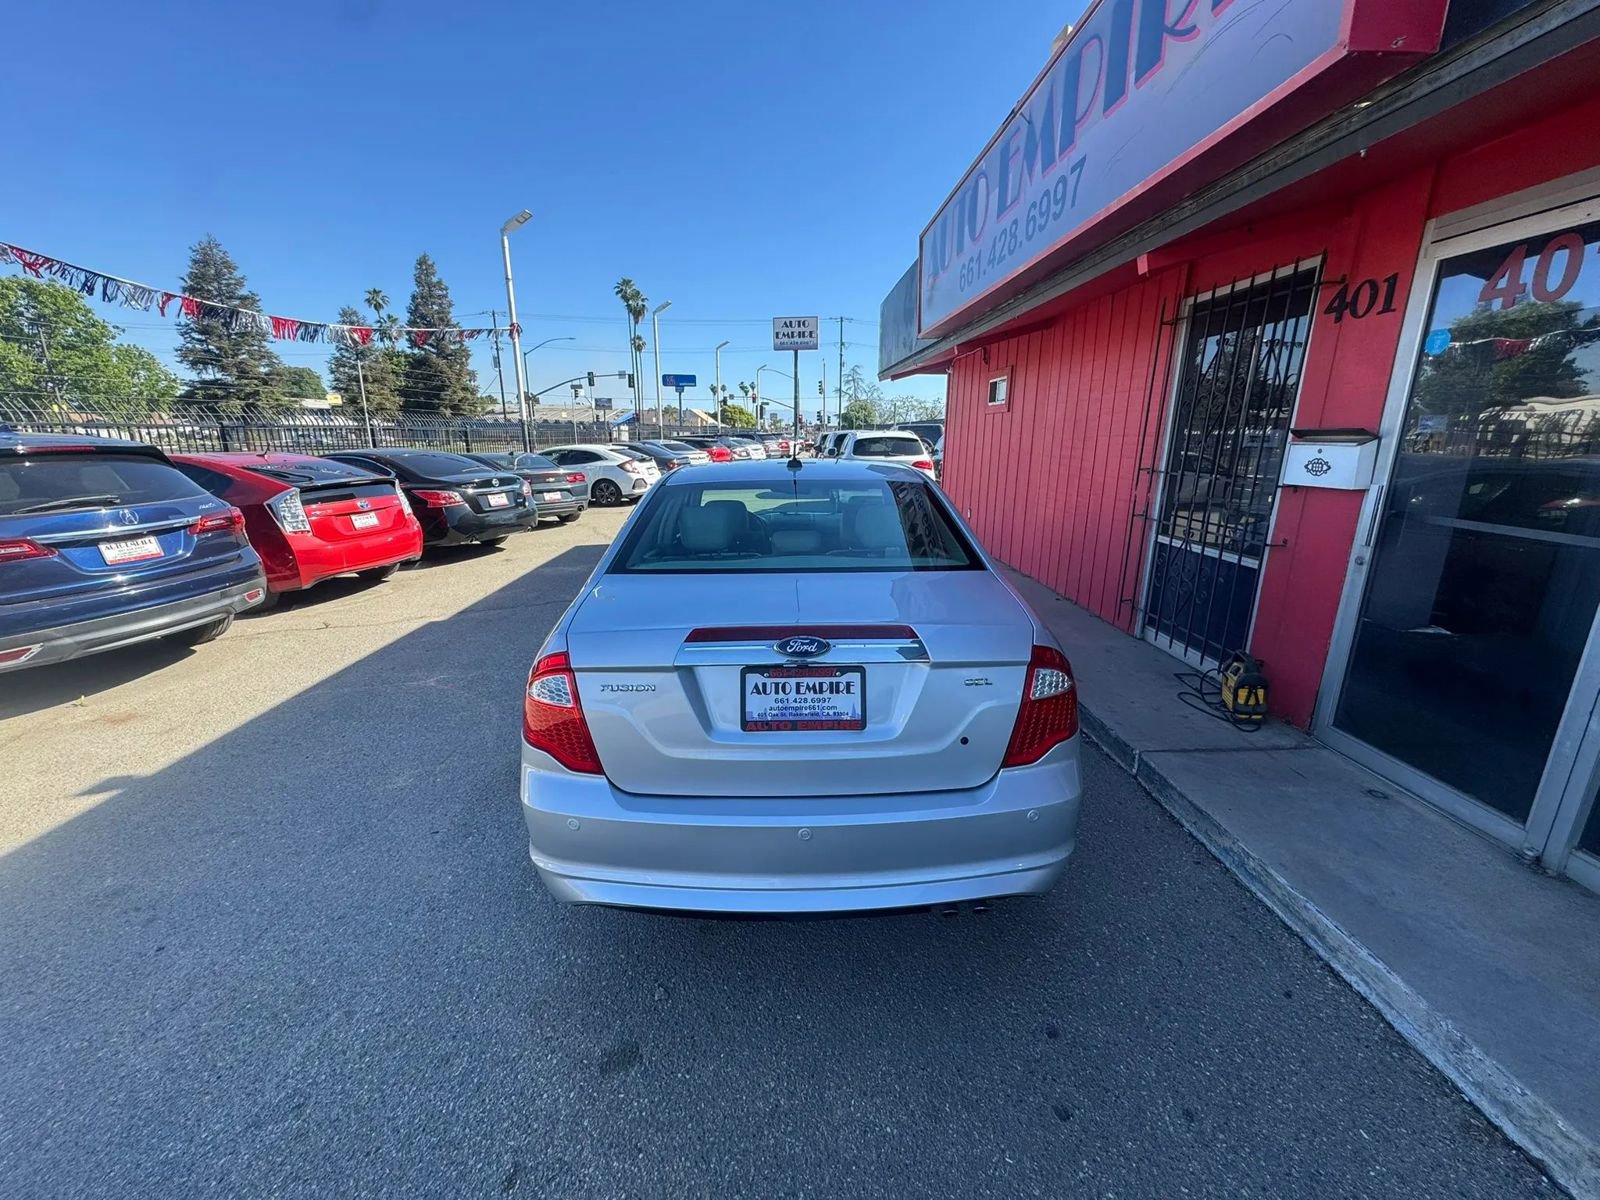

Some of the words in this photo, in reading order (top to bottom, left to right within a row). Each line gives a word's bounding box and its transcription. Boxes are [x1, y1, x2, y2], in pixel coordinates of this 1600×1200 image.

[927, 170, 990, 281] AUTO
[996, 0, 1236, 223] EMPIR
[959, 154, 1088, 293] 661.428.6997
[1477, 232, 1600, 310] 40
[1323, 272, 1399, 324] 401
[781, 320, 809, 329] AUTO
[775, 330, 816, 340] EMPIRE
[786, 638, 818, 653] Ford
[600, 683, 657, 693] FUSION
[750, 681, 792, 695] AUTO
[795, 681, 856, 695] EMPIRE
[774, 696, 832, 705] 661.428.6997
[768, 704, 838, 712] autoempire661.com
[746, 721, 793, 731] AUTO
[797, 721, 862, 731] EMPIRE
